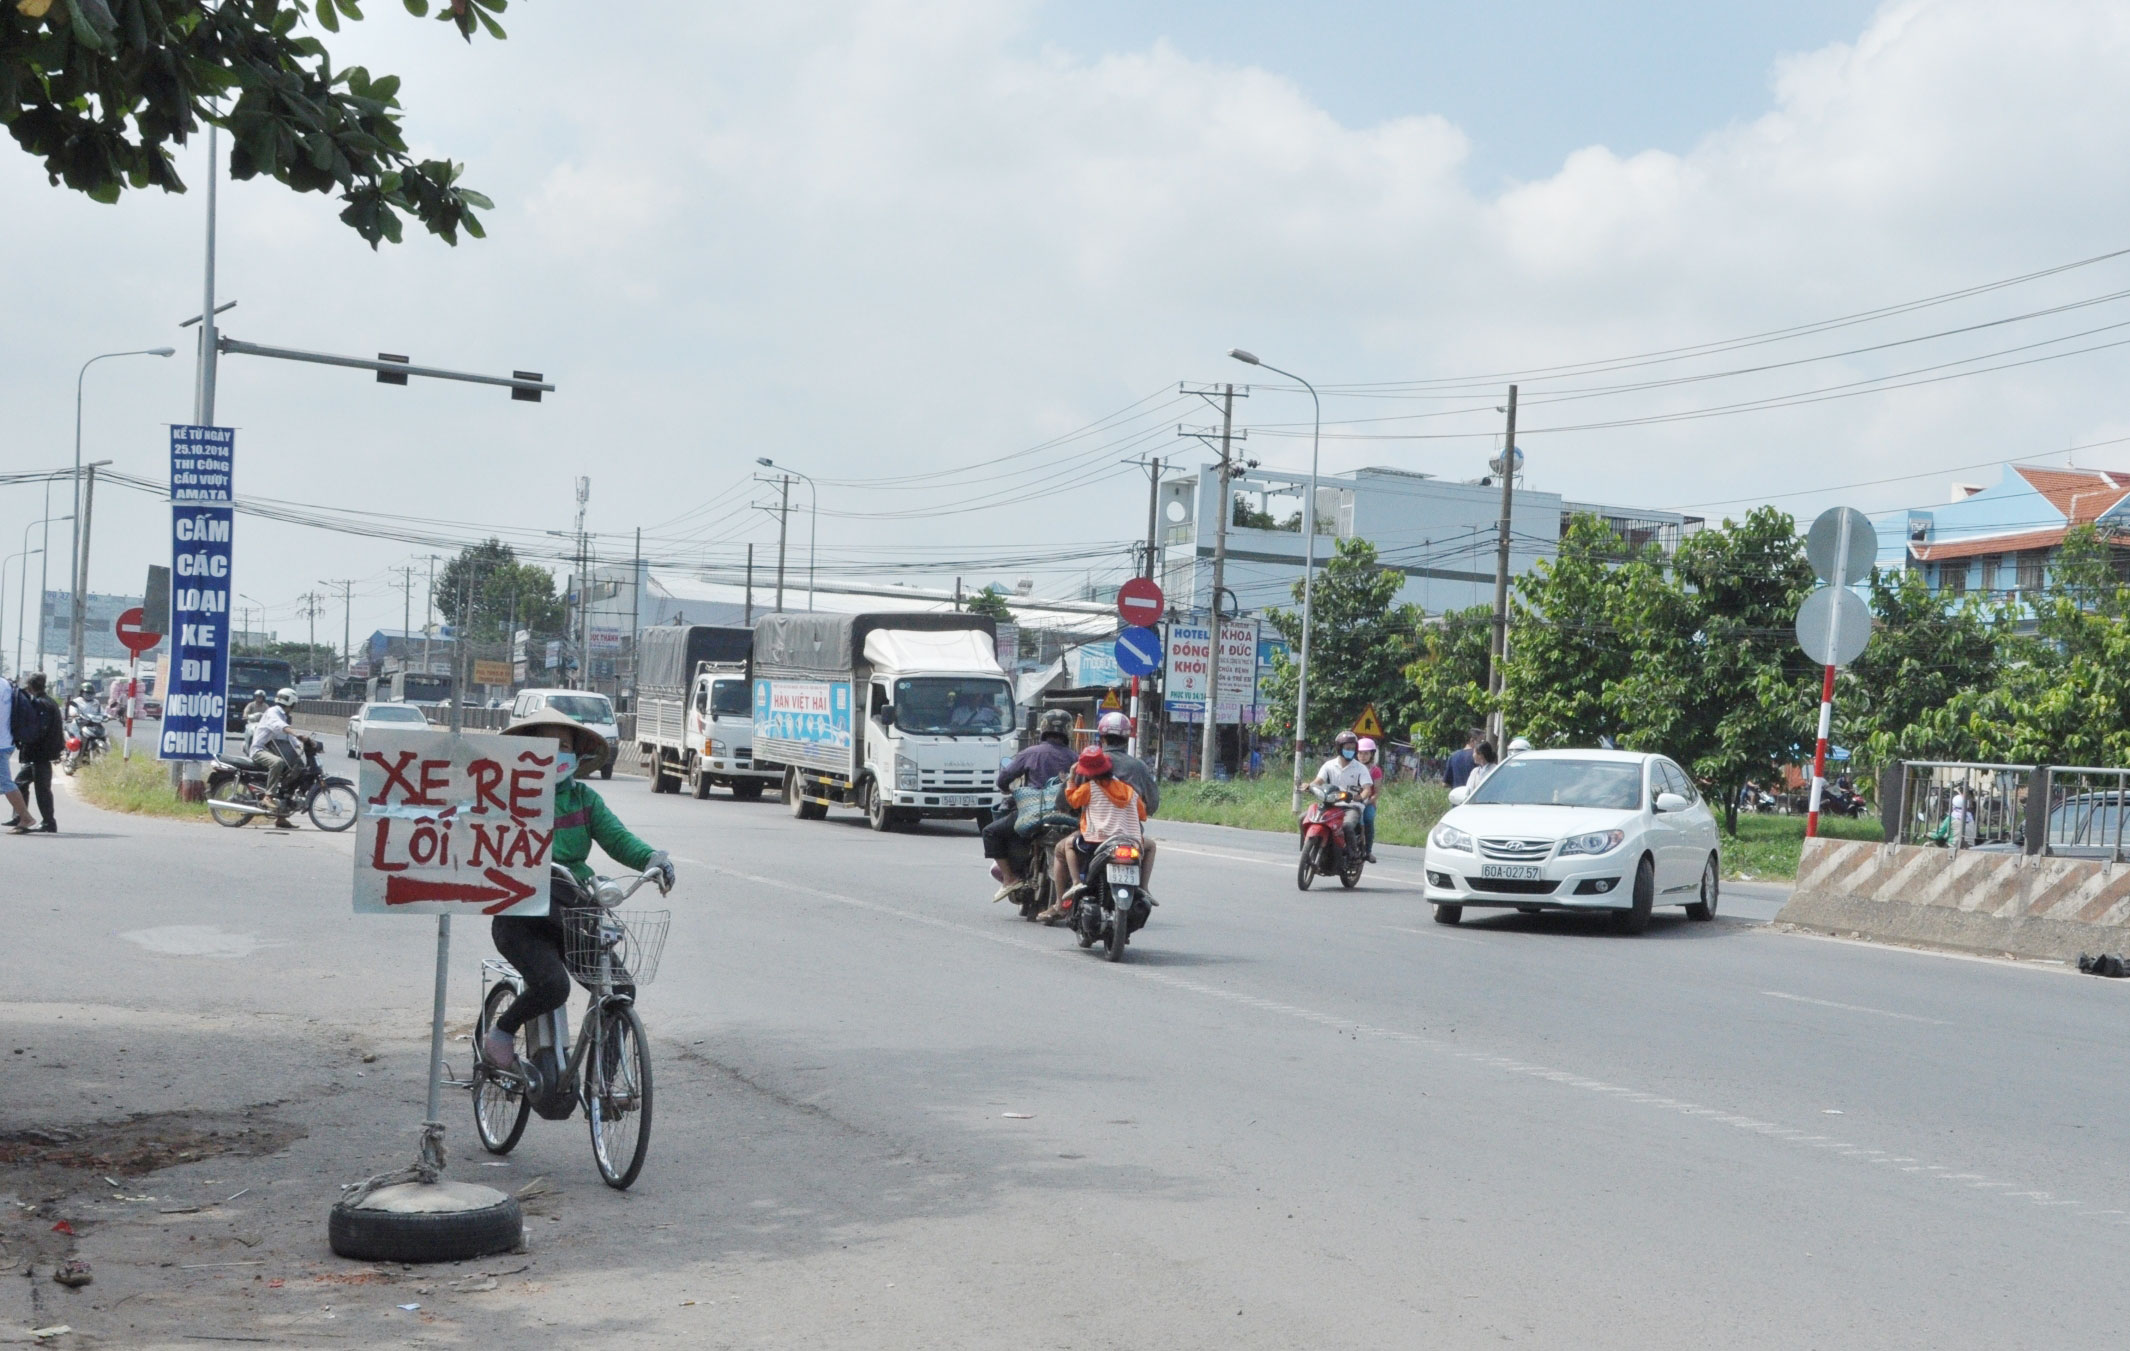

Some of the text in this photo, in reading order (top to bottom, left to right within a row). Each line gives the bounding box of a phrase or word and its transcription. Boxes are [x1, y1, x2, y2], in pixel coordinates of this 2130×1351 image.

[204, 428, 231, 442] NGÀY
[174, 444, 229, 457] 25.10.2014
[174, 458, 230, 472] THI CÔNG
[175, 488, 228, 501] AMATA
[176, 513, 230, 543] CẤM
[177, 549, 228, 578] CÁC
[176, 588, 226, 617] LOẠI
[180, 623, 216, 648] XE
[1221, 629, 1252, 642] KHOA
[1229, 642, 1252, 657] ĐỨC
[180, 659, 211, 682] ĐI
[167, 691, 223, 721] NGƯỢC
[163, 726, 221, 755] CHIỀU
[363, 751, 554, 818] XE RẼ
[466, 814, 555, 868] NÀY
